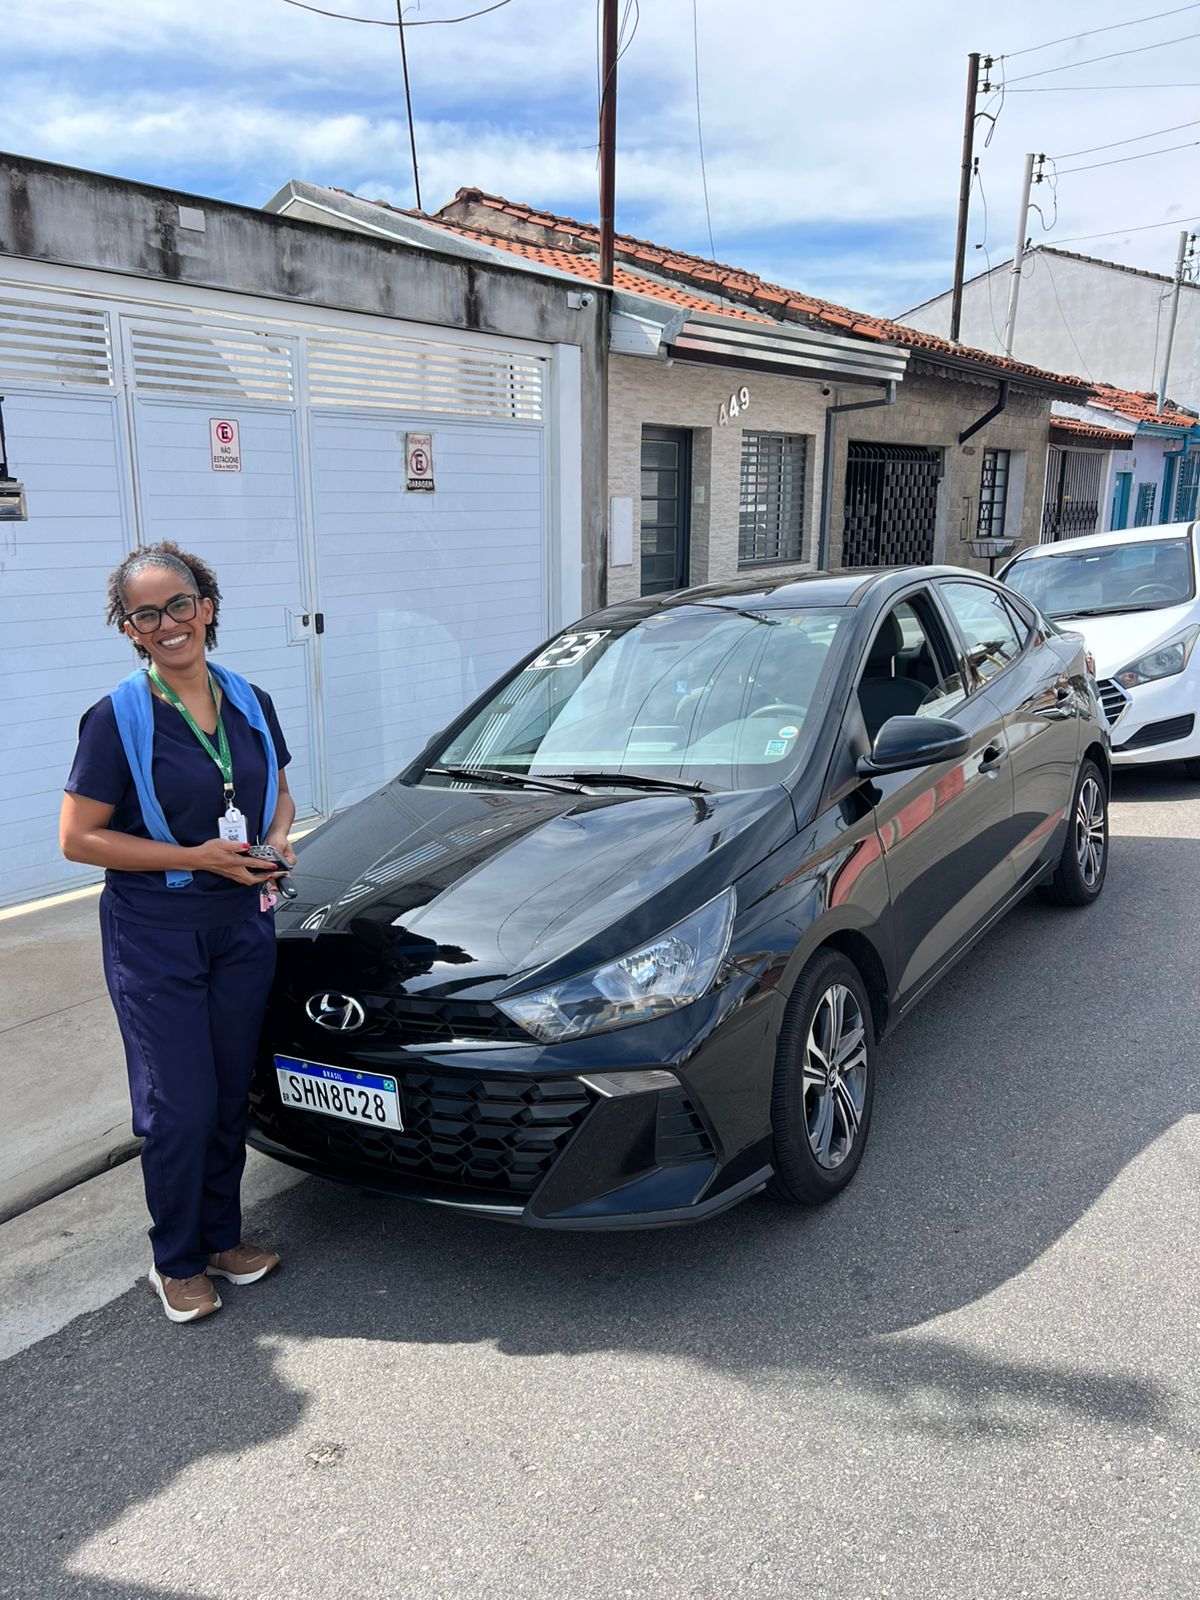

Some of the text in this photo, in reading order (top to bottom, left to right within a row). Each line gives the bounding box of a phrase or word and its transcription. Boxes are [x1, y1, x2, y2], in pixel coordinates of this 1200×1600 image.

[719, 387, 750, 426] 449
[220, 446, 231, 454] NÃO
[214, 455, 239, 464] ESTACIONE
[408, 480, 433, 488] GARAGEM
[534, 633, 601, 667] 23
[323, 1070, 343, 1081] BRASIL
[282, 1092, 291, 1102] BR
[289, 1075, 387, 1123] SHN8C28
